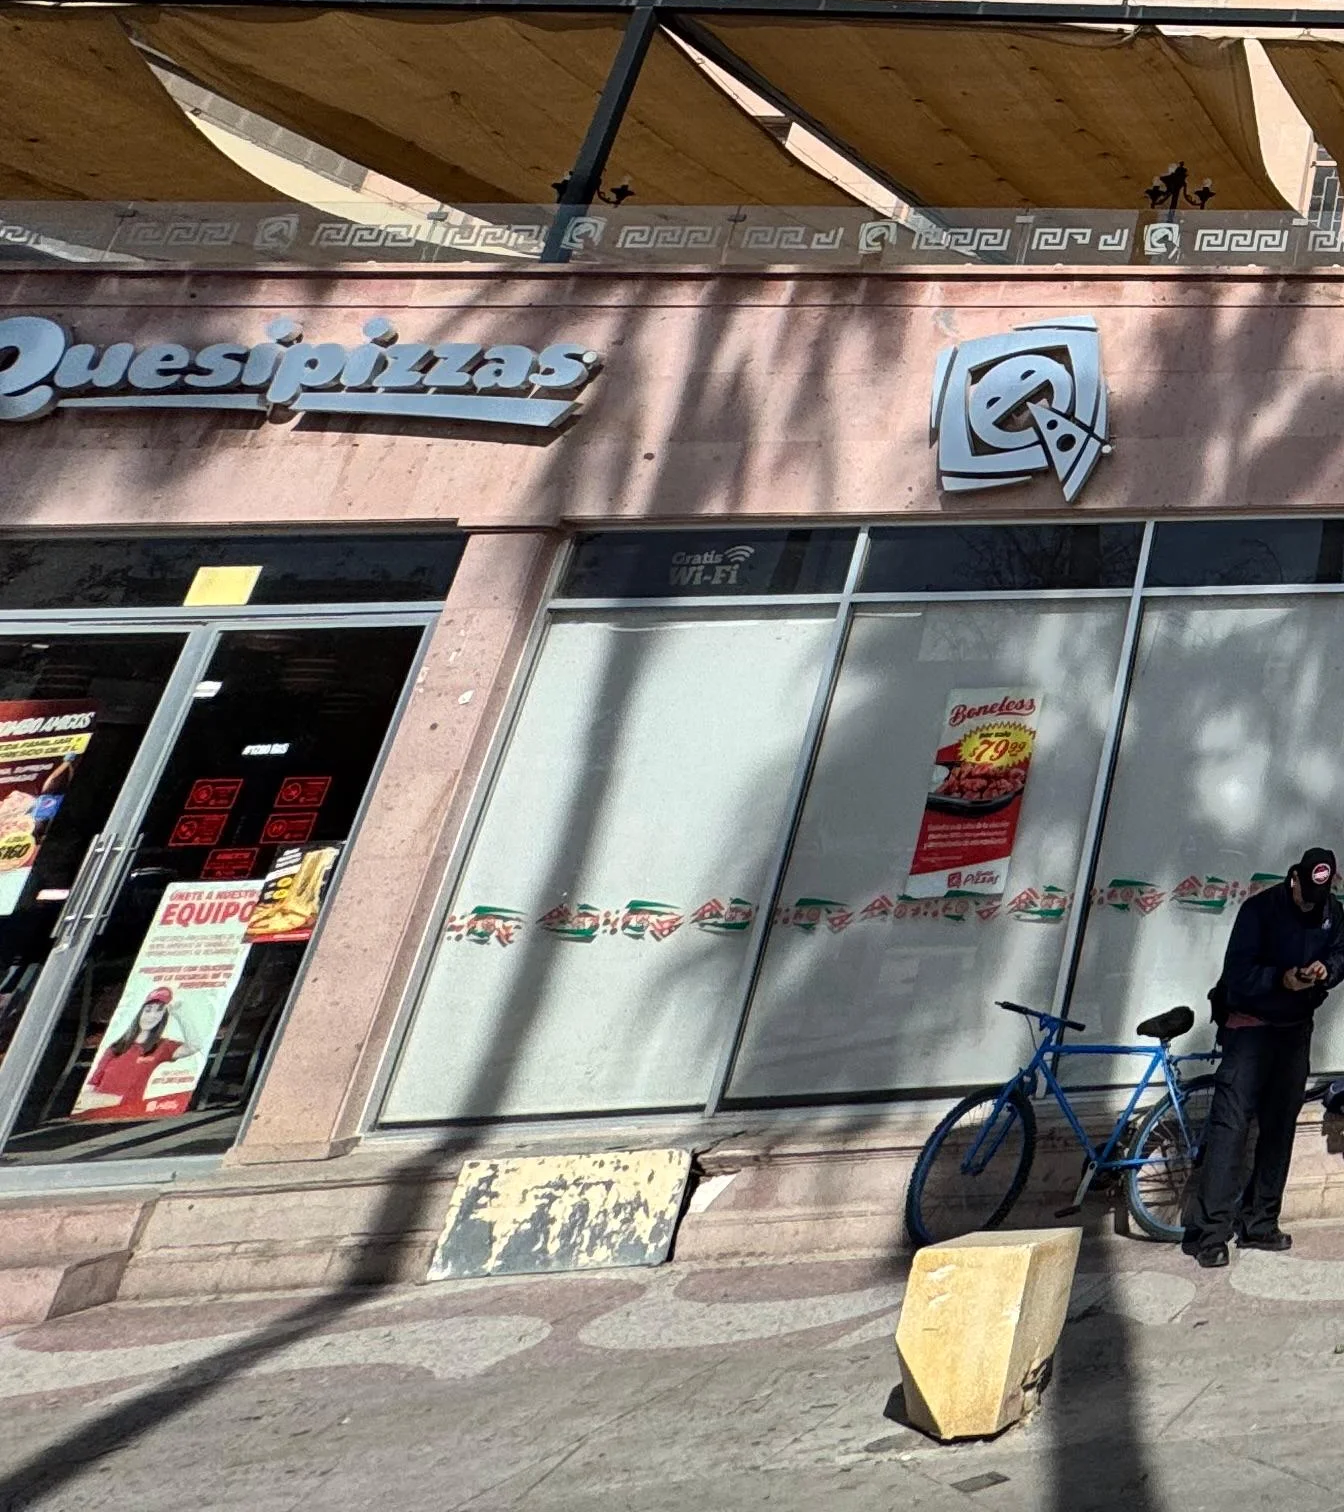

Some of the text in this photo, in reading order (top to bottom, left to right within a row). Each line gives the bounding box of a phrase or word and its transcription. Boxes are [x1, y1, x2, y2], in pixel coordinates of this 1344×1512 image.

[0, 315, 590, 421] Quesipizzas
[671, 550, 723, 565] Gratis
[669, 563, 740, 586] Wi-Fi
[949, 695, 1036, 727] Boneless
[159, 901, 257, 927] EQUIPO
